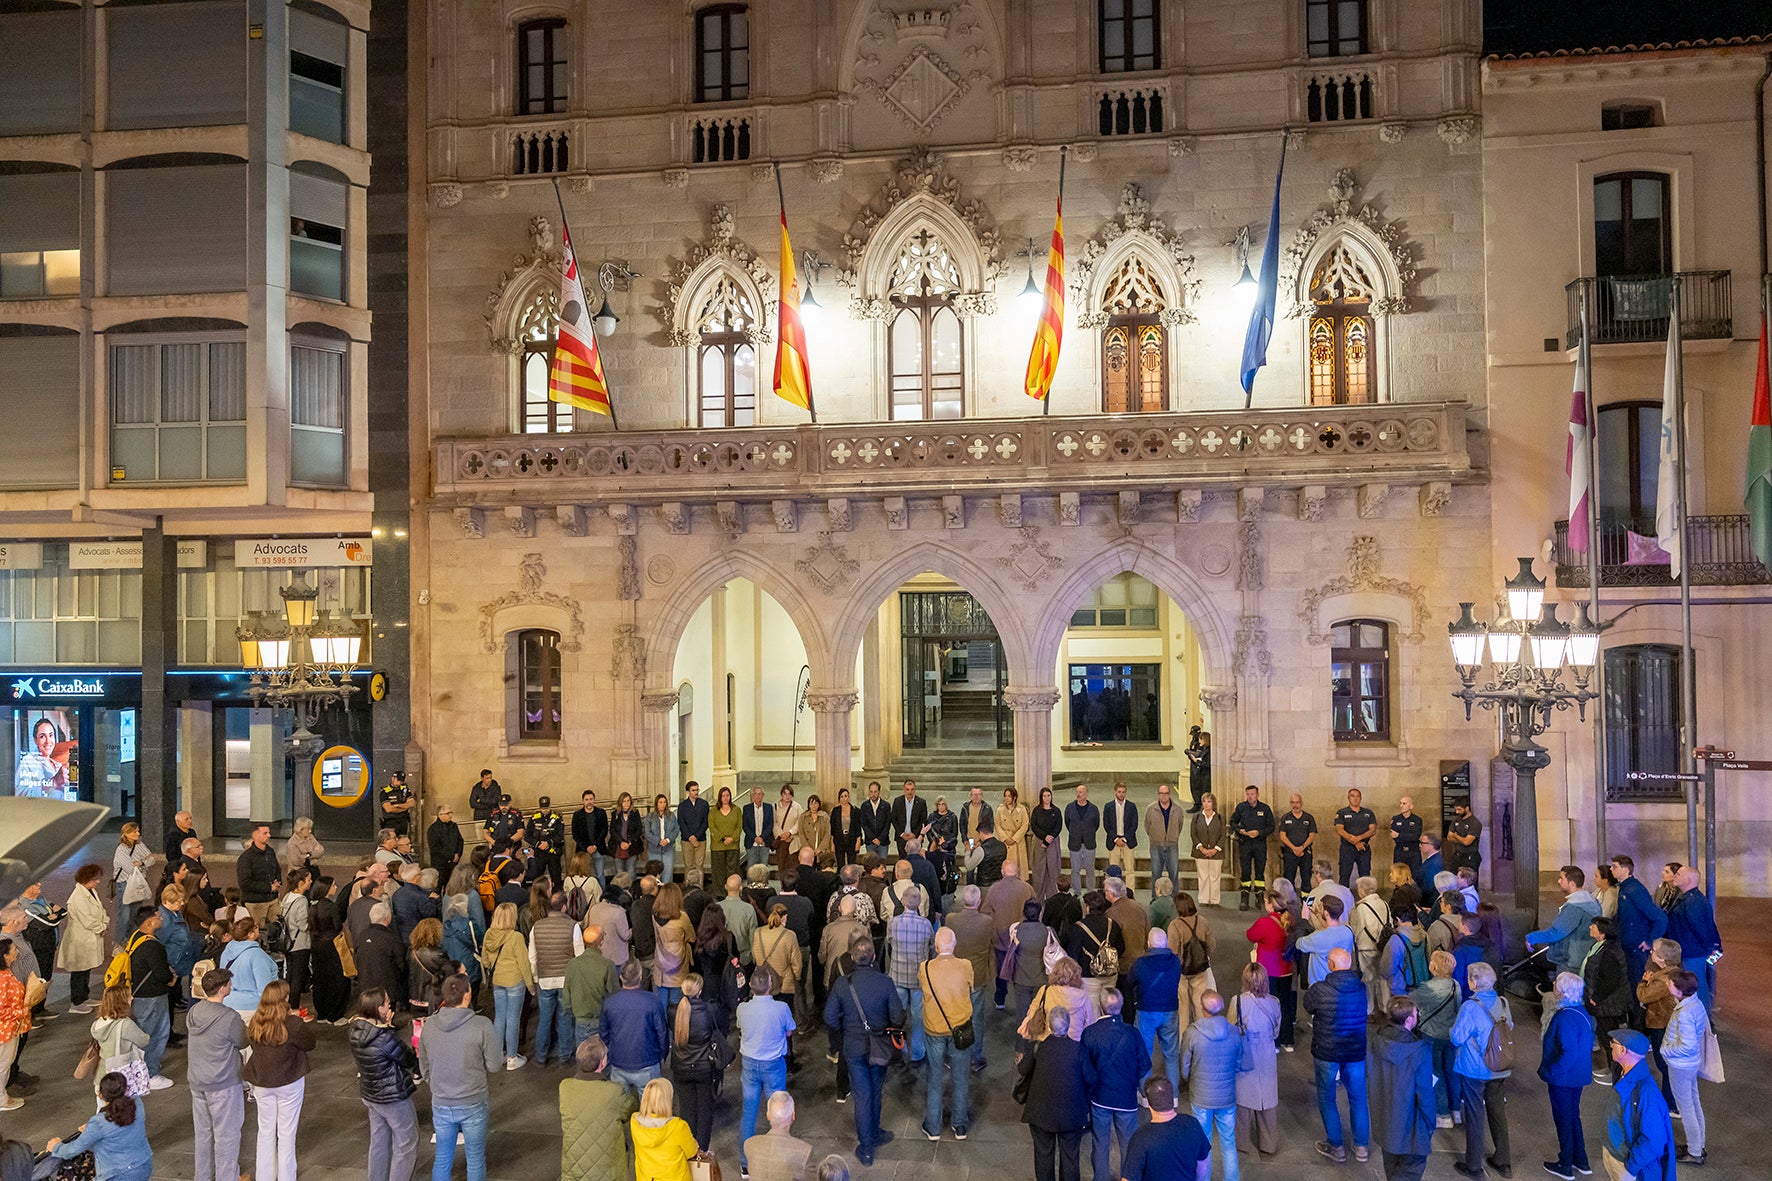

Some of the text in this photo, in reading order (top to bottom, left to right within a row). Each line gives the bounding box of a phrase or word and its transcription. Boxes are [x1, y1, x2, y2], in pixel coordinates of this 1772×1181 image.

[254, 543, 308, 554] Advocats
[338, 541, 361, 550] Amb
[79, 547, 110, 555] Advocats
[262, 557, 271, 565] 93
[273, 557, 287, 565] 595
[299, 556, 308, 564] 77
[38, 679, 104, 694] CaixaBank
